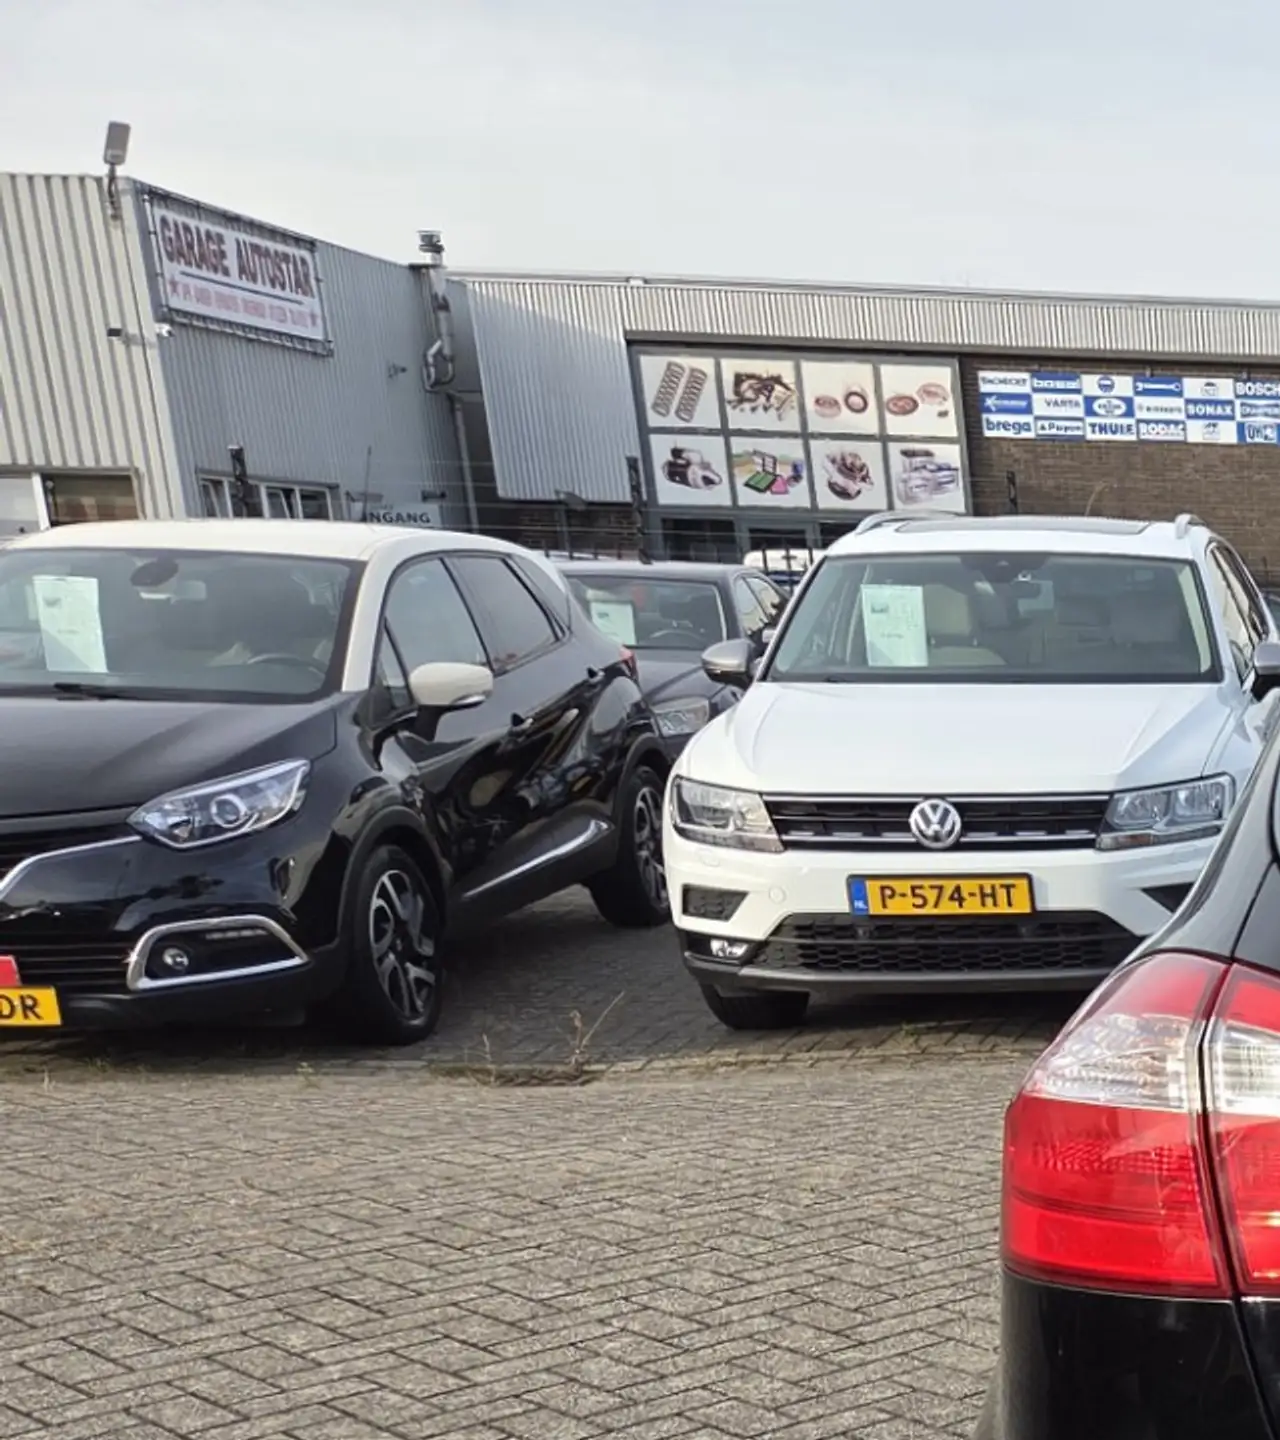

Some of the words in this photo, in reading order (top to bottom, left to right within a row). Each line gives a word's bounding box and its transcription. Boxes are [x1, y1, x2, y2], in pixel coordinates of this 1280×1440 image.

[160, 214, 231, 278] GARAGE
[235, 237, 315, 299] AUTOSTAR
[985, 417, 1032, 435] brega
[1088, 422, 1135, 436] THULE
[879, 883, 1017, 910] P-574-HT
